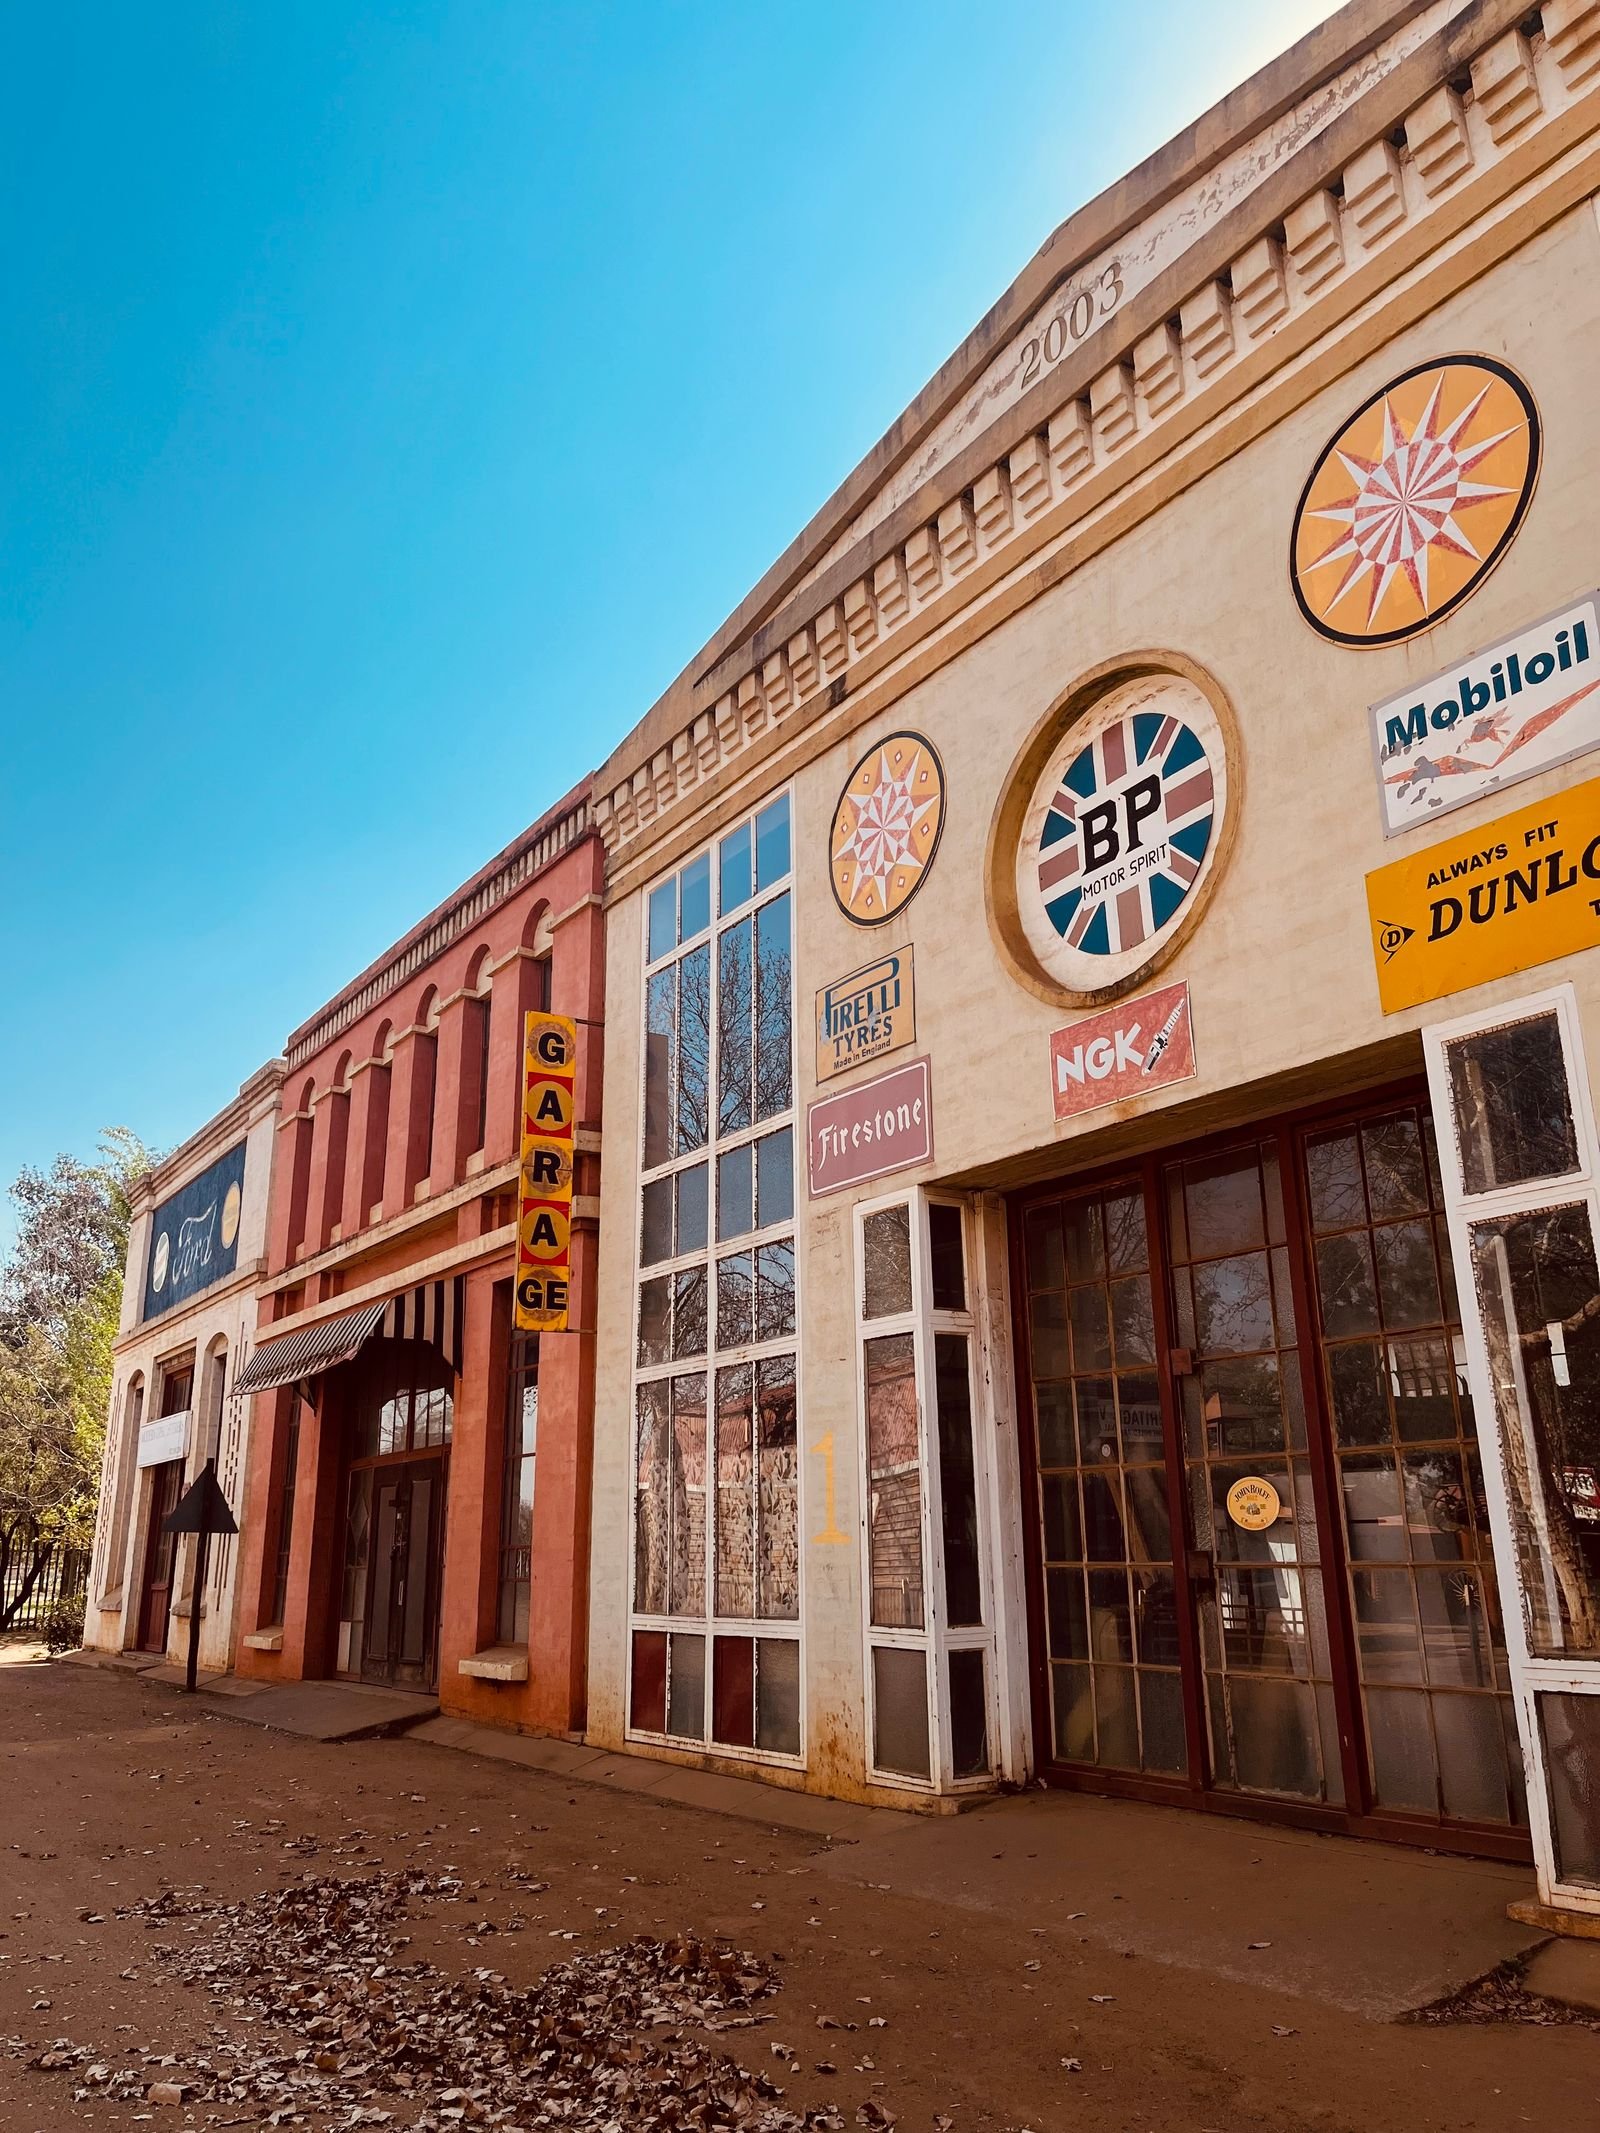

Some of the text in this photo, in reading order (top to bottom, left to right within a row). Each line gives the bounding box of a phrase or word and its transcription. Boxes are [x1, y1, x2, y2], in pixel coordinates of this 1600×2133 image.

[1021, 262, 1124, 390] 2003
[1384, 620, 1591, 754] Mobiloil
[1078, 773, 1162, 877] BP
[1426, 820, 1559, 889] ALWAYS FIT
[1083, 843, 1168, 901] MOTOR SPIRIT
[825, 957, 901, 1038] PIRELLI
[833, 1015, 893, 1058] TYRES
[833, 1039, 891, 1071] Made in England
[1056, 1022, 1145, 1093] NGK
[517, 1032, 568, 1311] GARAGE
[817, 1098, 923, 1173] Firestone
[173, 1198, 217, 1285] Ford
[810, 1431, 852, 1545] 1
[1234, 1487, 1251, 1502] JOHN
